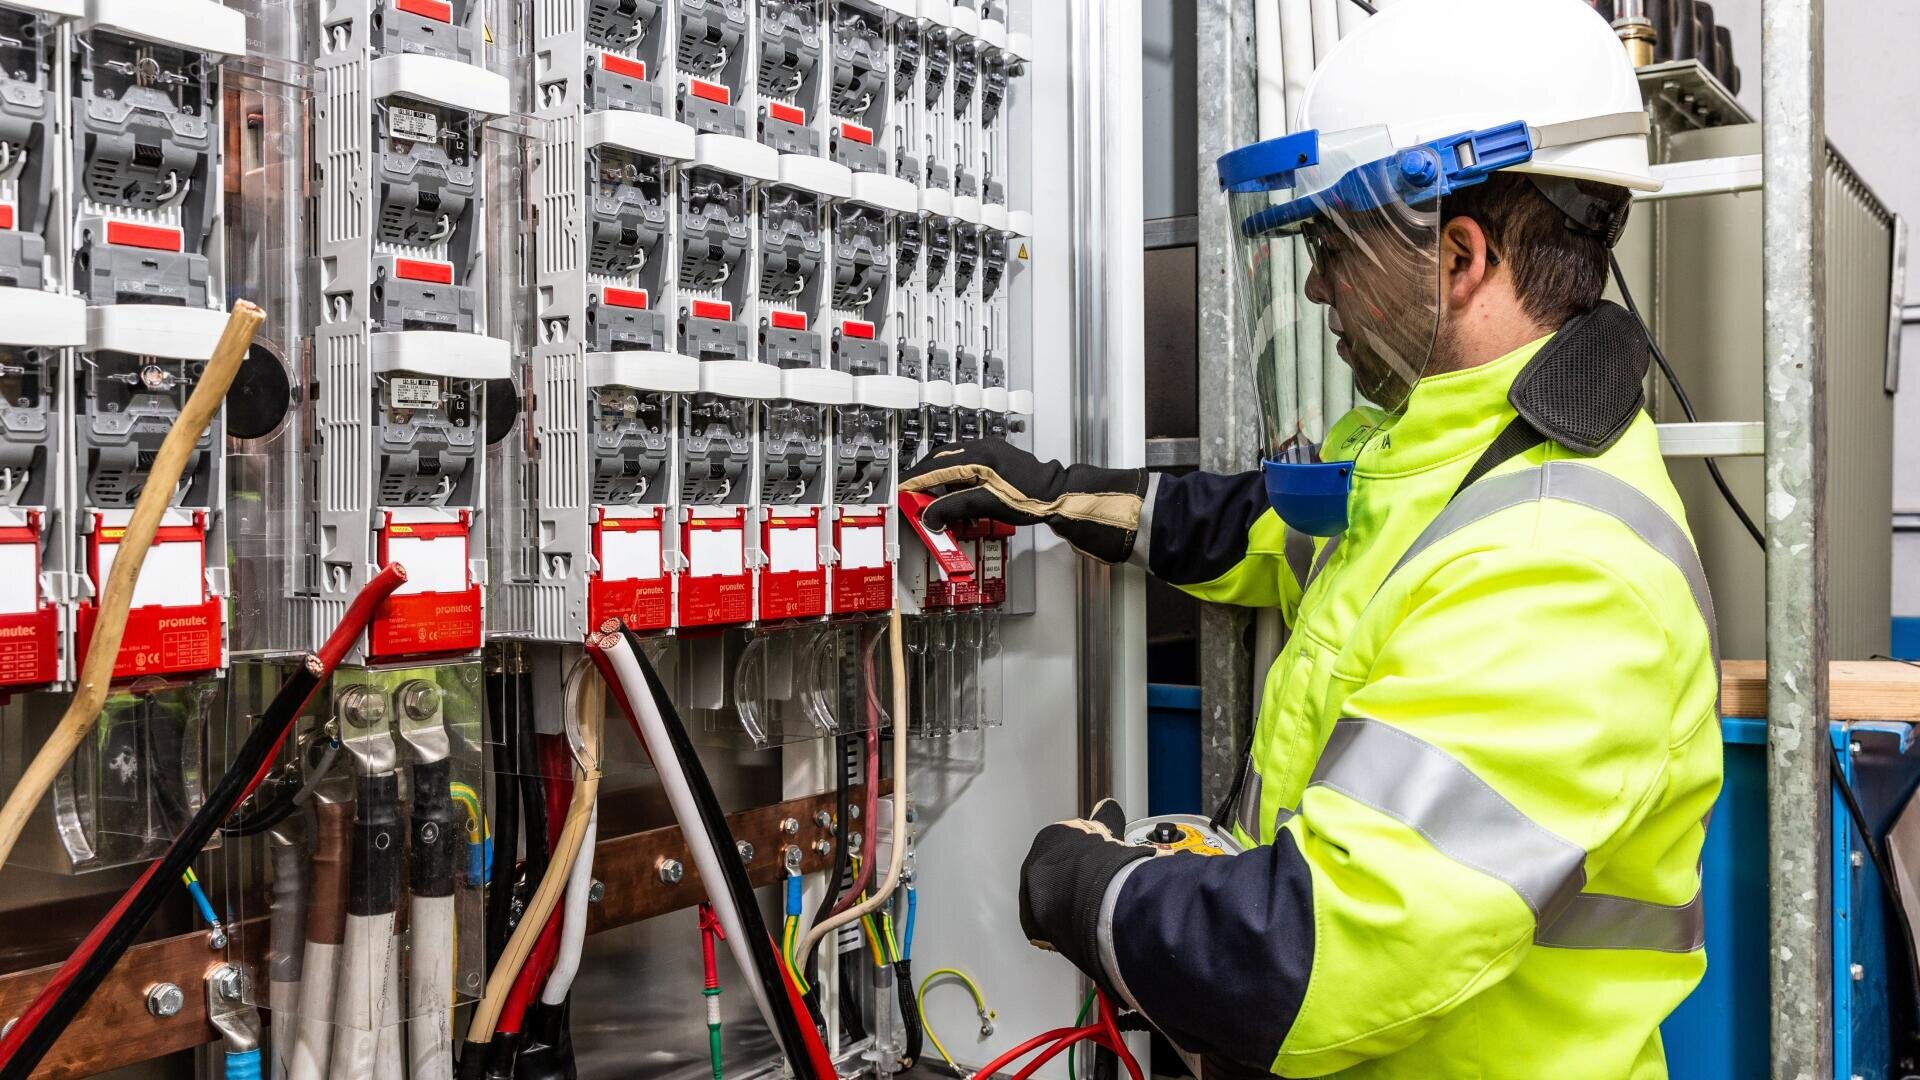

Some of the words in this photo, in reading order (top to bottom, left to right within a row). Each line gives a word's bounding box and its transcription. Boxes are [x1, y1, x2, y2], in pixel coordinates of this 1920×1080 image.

[456, 141, 465, 150] L2
[456, 401, 465, 410] L3
[796, 578, 819, 588] pronutec
[863, 574, 885, 584] pronutec
[635, 587, 664, 596] pronutec
[719, 582, 745, 593] pronutec
[435, 604, 473, 616] pronutec
[159, 616, 207, 631] pronutec
